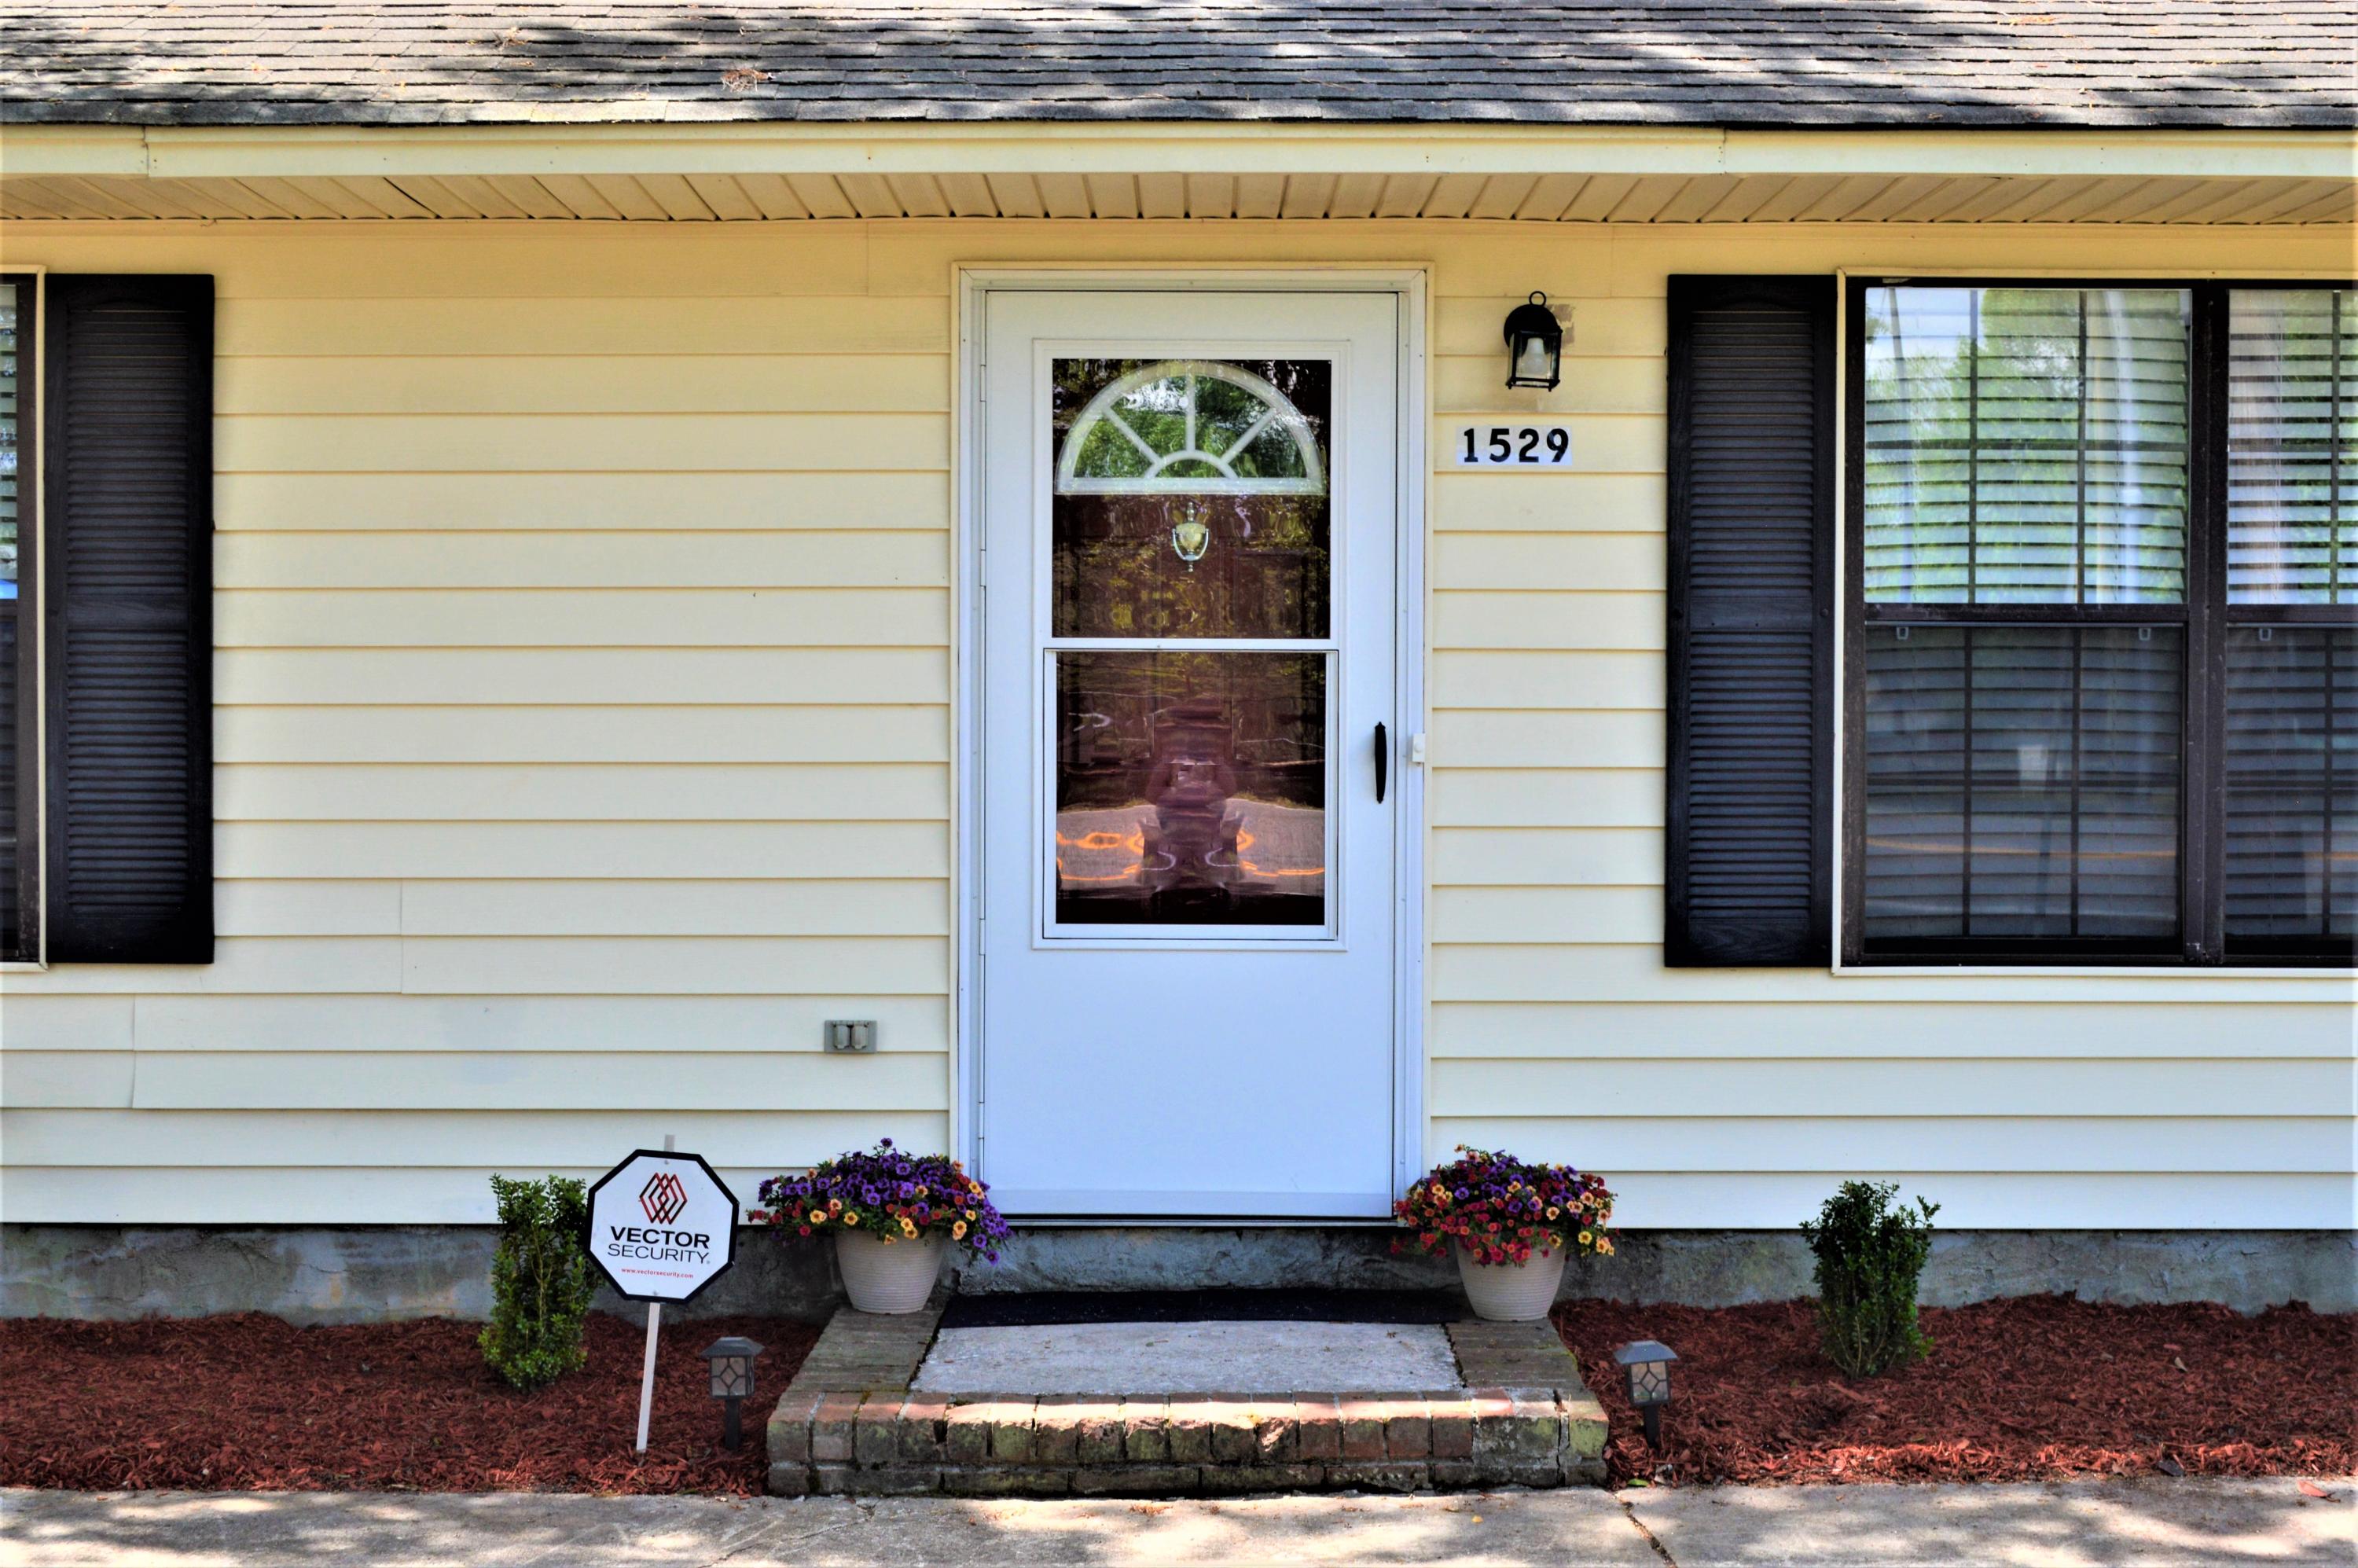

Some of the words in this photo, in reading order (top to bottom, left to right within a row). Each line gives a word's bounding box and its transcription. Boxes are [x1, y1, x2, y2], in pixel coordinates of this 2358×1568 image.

[1464, 428, 1569, 463] 1529
[610, 1226, 711, 1249] VECTOR
[607, 1243, 710, 1264] SECURITY
[621, 1267, 694, 1280] www.vectorsecurity.com
